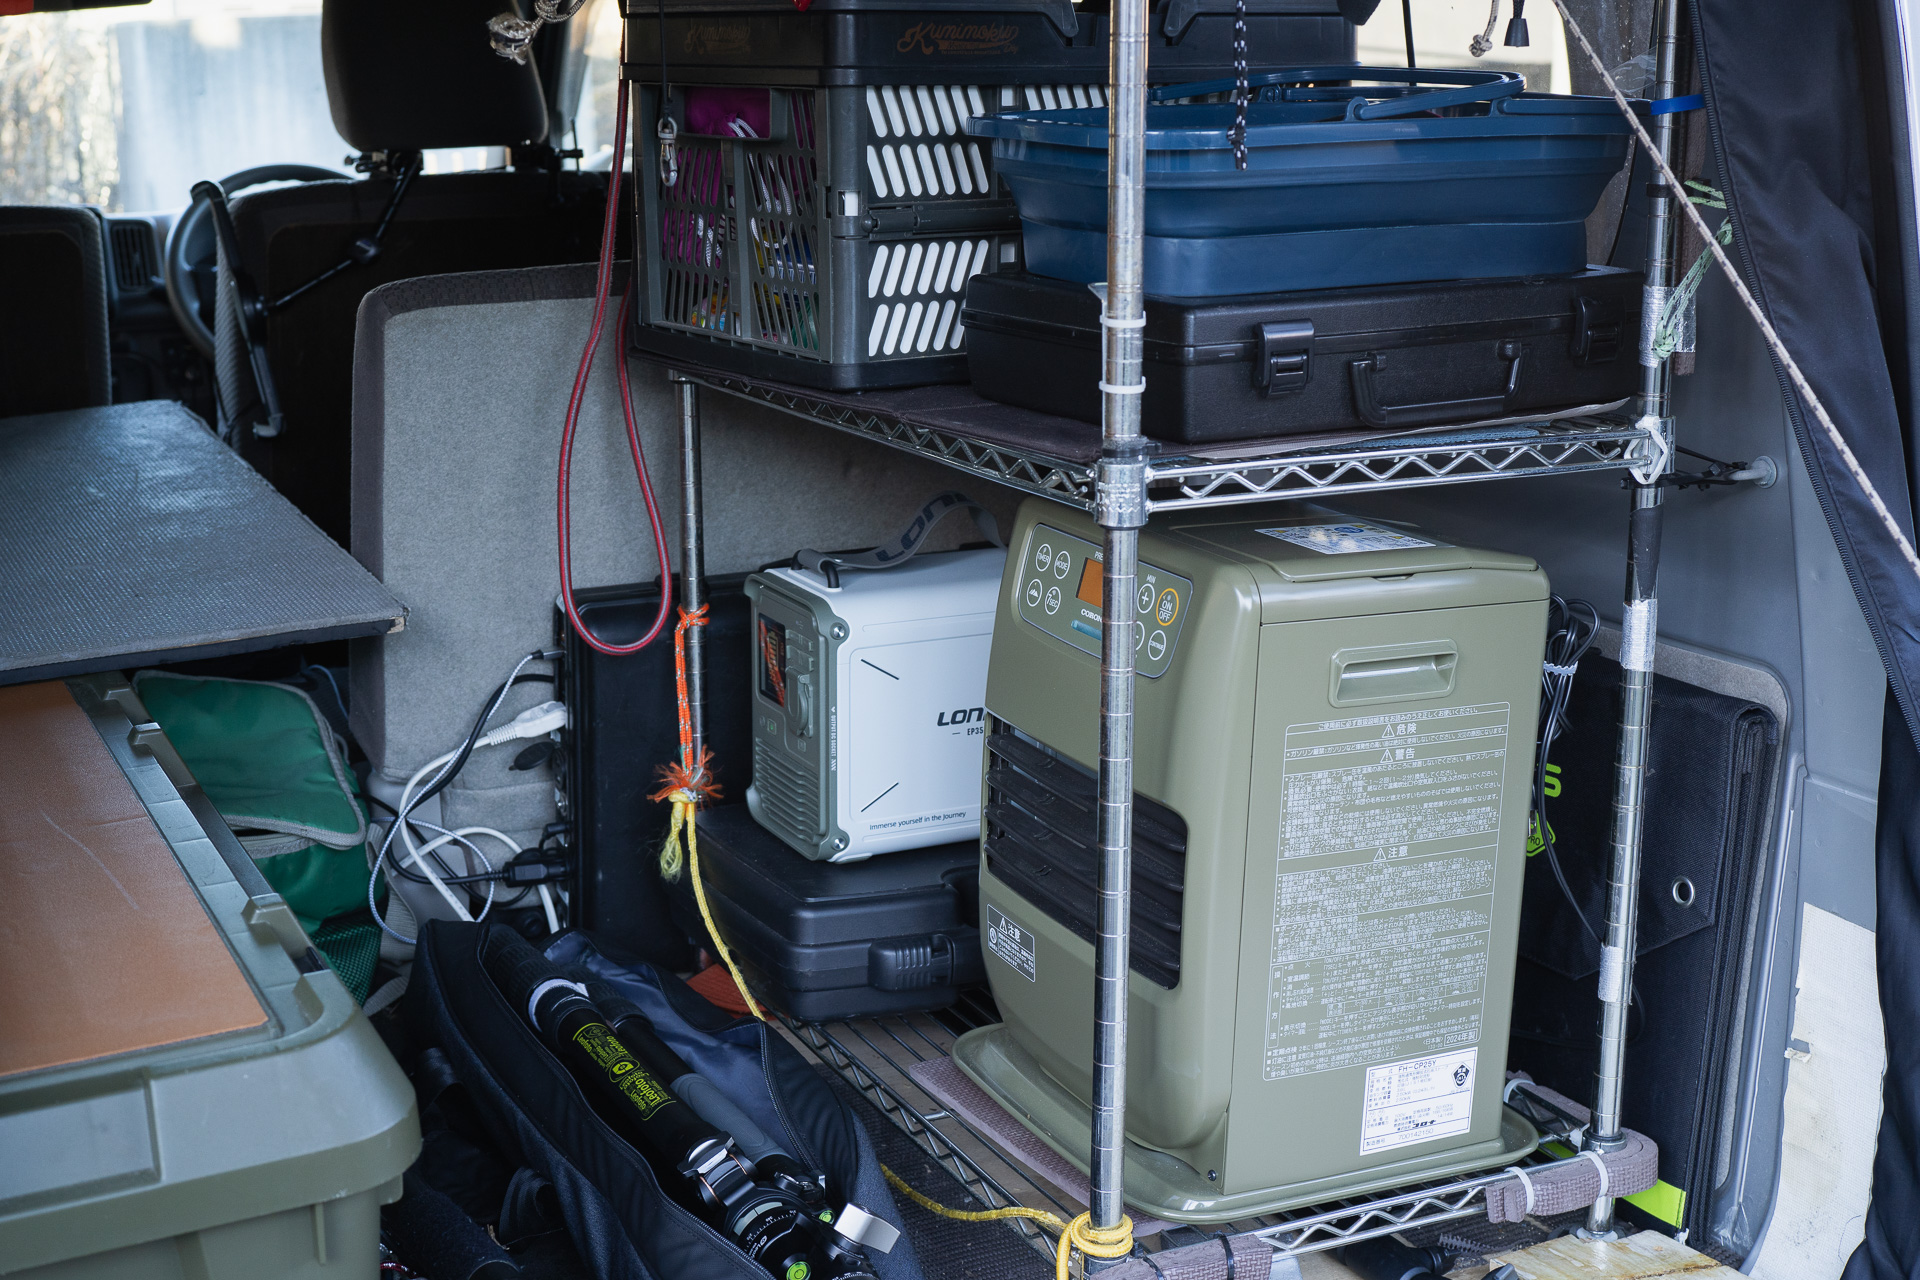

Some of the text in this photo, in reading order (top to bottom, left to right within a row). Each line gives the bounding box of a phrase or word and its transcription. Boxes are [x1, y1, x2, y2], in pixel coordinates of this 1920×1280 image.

[897, 21, 1019, 55] Kumimoku
[1037, 553, 1050, 564] TIMER
[1055, 559, 1068, 571] MODE
[1161, 600, 1173, 611] ON
[1080, 608, 1103, 622] CORON
[1159, 611, 1171, 622] OFF
[937, 707, 985, 727] LON
[967, 727, 984, 736] EP35
[1396, 722, 1417, 736] 危険
[1394, 746, 1415, 761] 警告
[869, 811, 967, 831] Immerse yourself in the Journey
[1387, 845, 1408, 858] 注意
[1007, 922, 1021, 943] 注意
[577, 1033, 592, 1053] Leofoto
[1445, 1030, 1476, 1044] 2024年製
[1398, 1060, 1437, 1072] FH-CP25Y
[635, 1078, 662, 1107] Leofoto
[1398, 1129, 1433, 1140] 700142150
